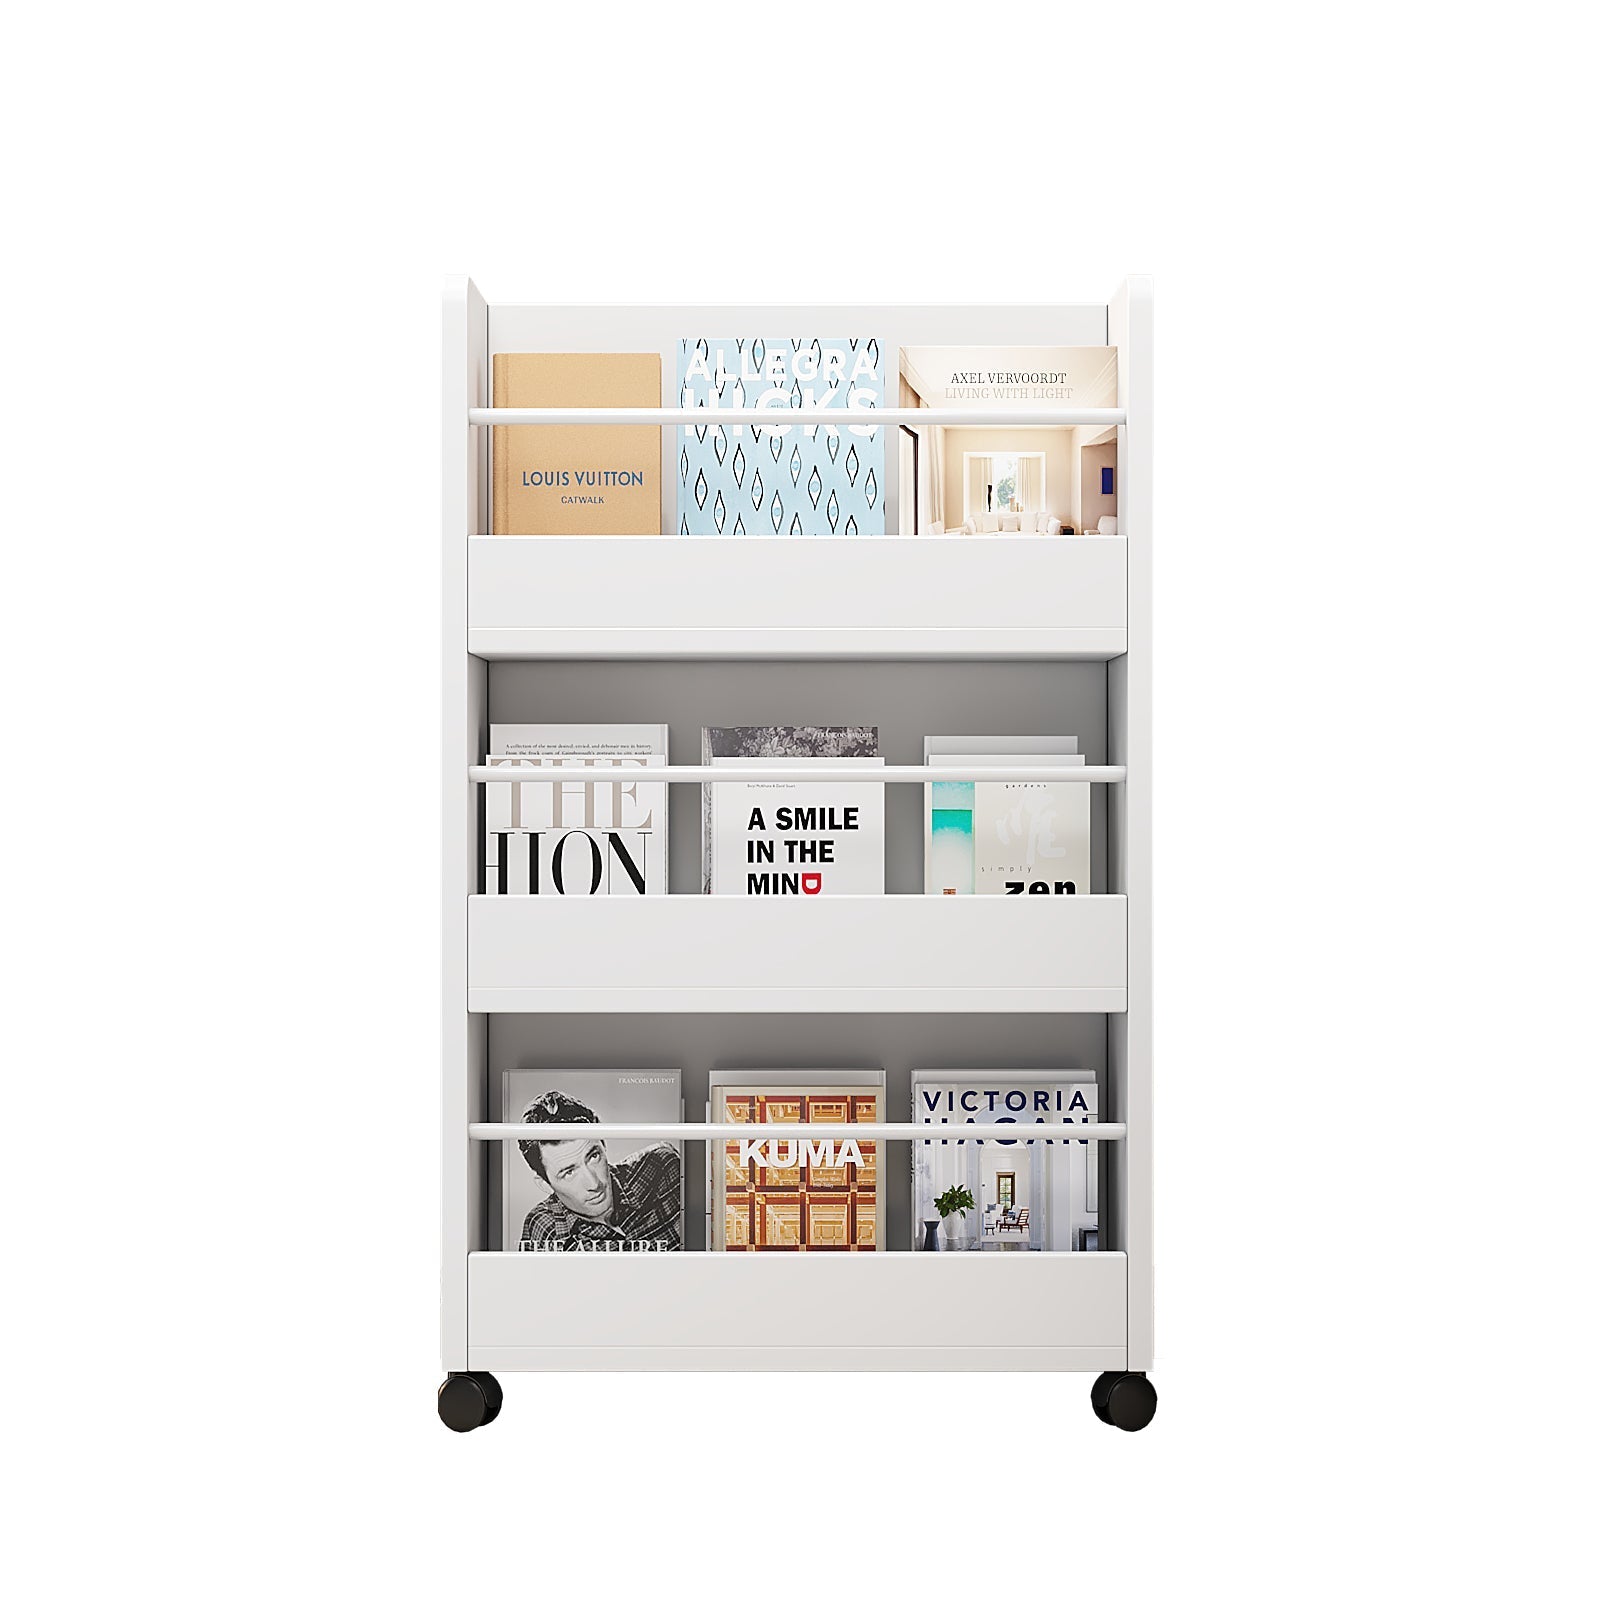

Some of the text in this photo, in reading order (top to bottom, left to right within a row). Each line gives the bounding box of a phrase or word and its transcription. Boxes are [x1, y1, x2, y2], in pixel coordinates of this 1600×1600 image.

[685, 349, 878, 381] ALLEGRA
[951, 373, 1066, 384] AXEL VERVOORDT
[944, 388, 1073, 398] LIVING WITH LIGHT
[685, 388, 878, 437] HICKS
[523, 471, 643, 486] LOUIS VUITTON
[491, 759, 652, 828] THE
[748, 808, 858, 830] A SMILE
[748, 840, 834, 863] IN THE
[748, 873, 822, 894] MIND
[1005, 882, 1076, 894] zen
[923, 1091, 1088, 1111] VICTORIA
[740, 1139, 865, 1168] KUMA
